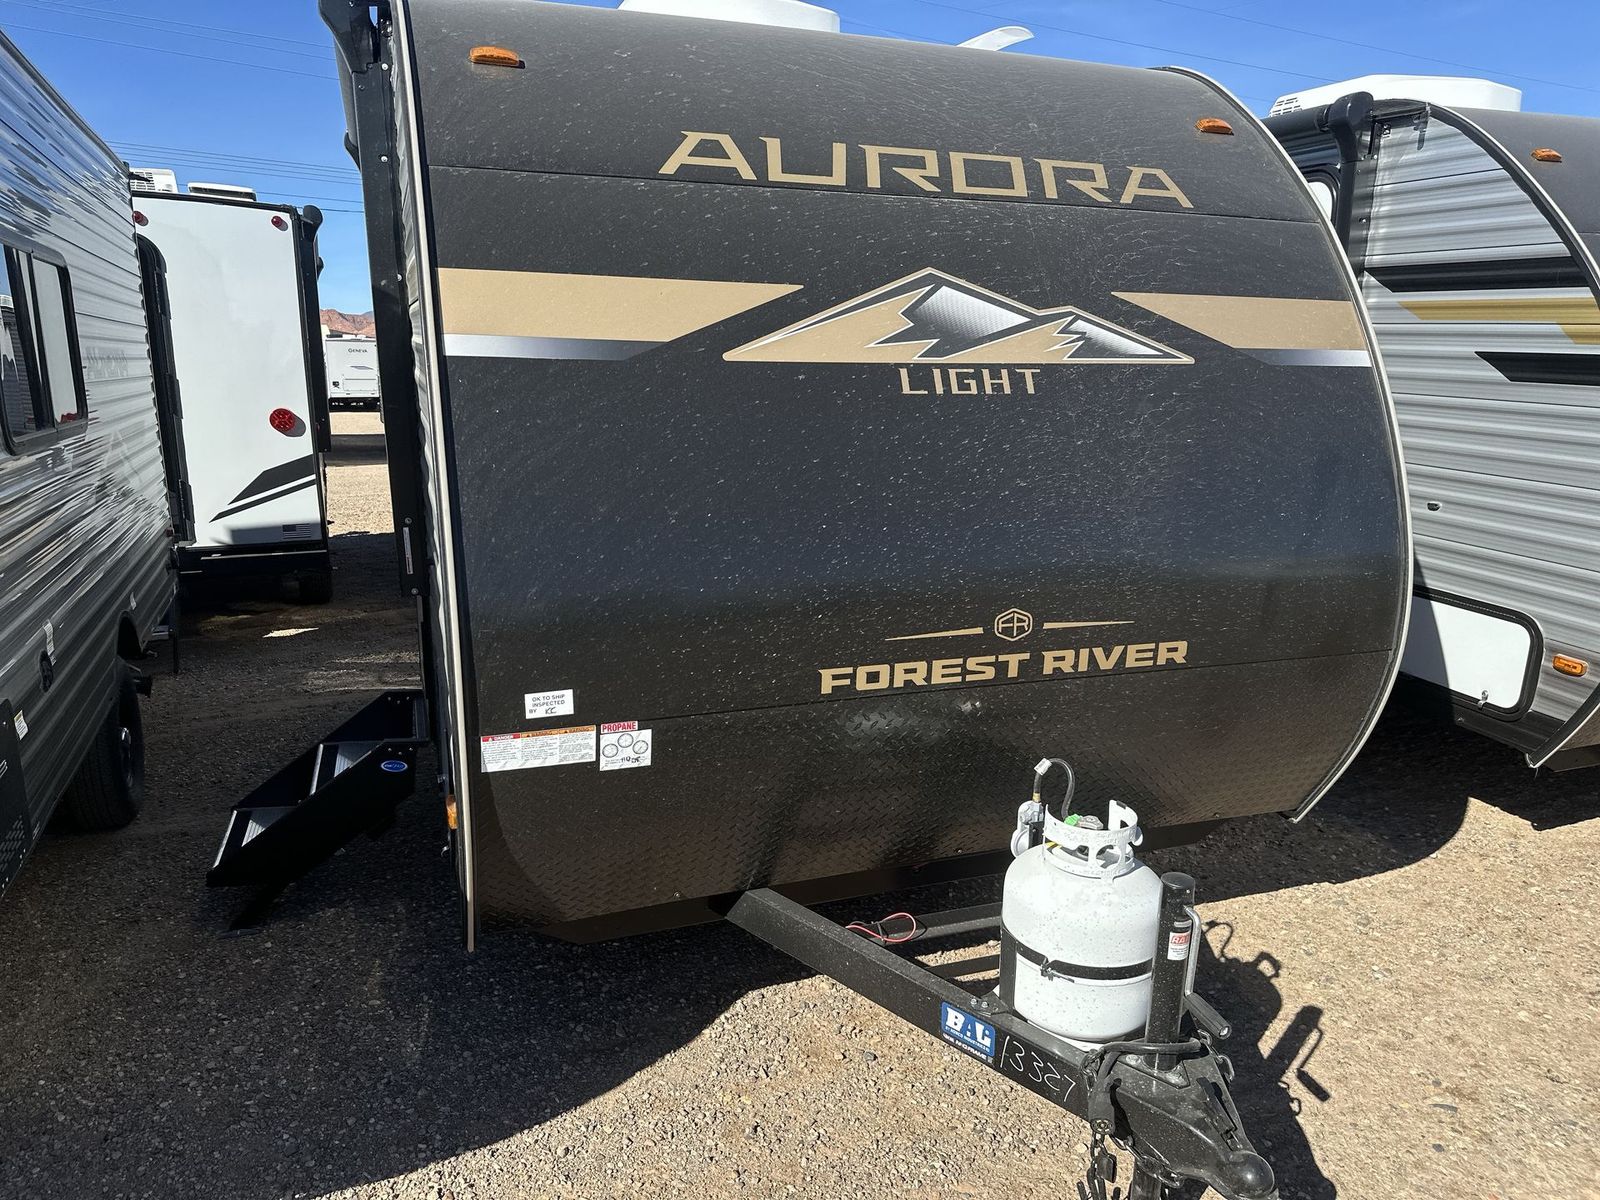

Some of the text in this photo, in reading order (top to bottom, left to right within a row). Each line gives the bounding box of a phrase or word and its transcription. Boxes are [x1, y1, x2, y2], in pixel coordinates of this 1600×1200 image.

[657, 130, 1194, 208] AURORA
[899, 368, 1041, 395] LIGHT
[818, 640, 1189, 695] FOREST RIVER
[602, 722, 637, 733] PROPANE
[1000, 1035, 1076, 1102] 13327
